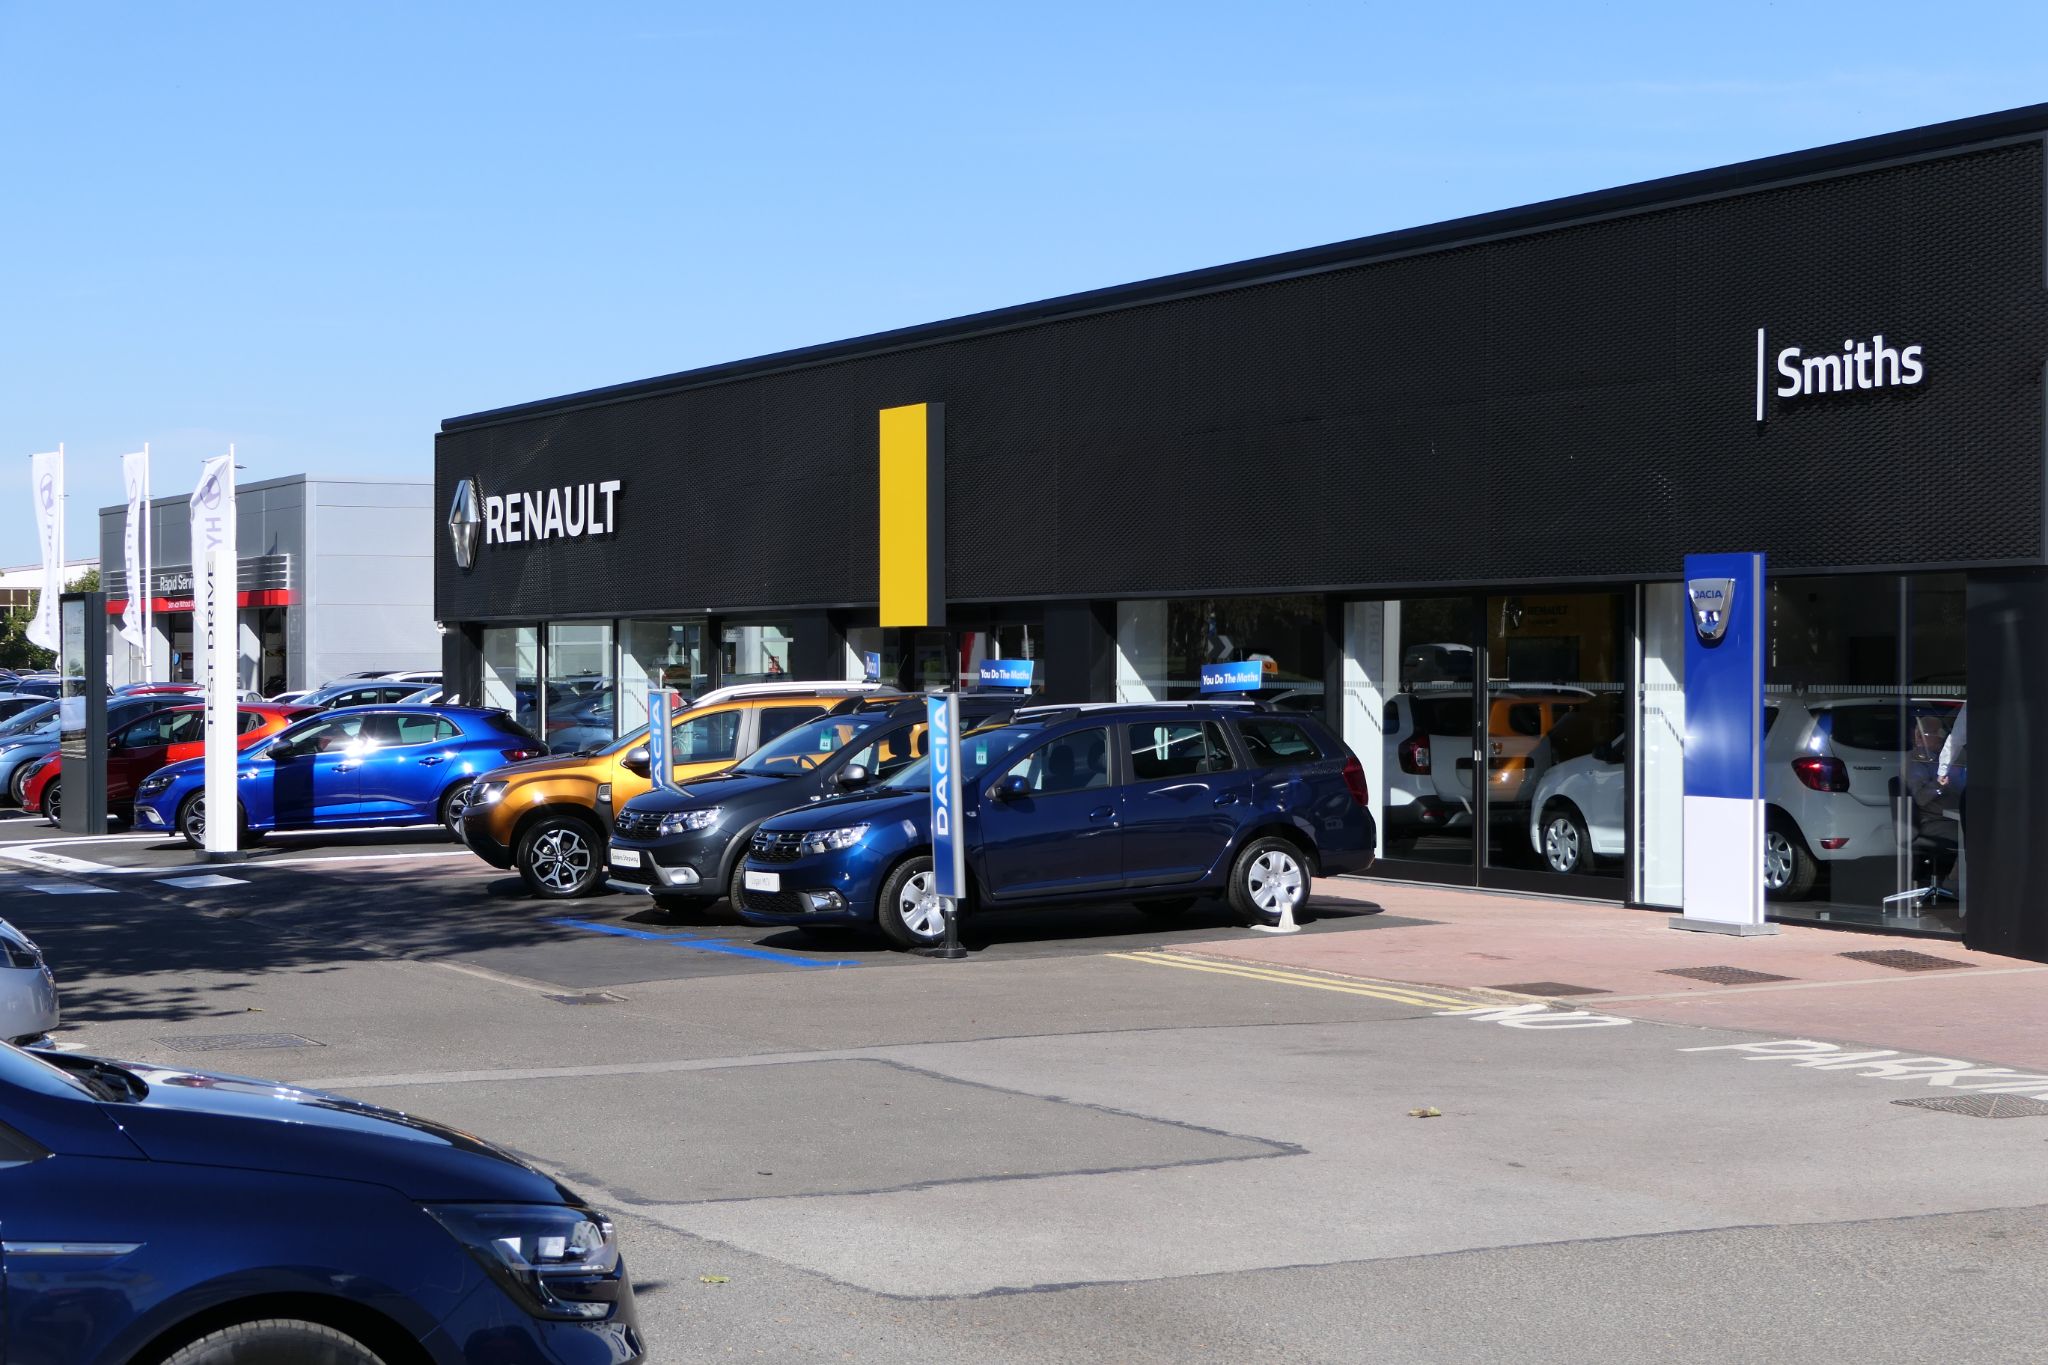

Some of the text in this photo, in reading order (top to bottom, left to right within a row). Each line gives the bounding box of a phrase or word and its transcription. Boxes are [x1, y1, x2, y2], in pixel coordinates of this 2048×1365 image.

[1777, 335, 1923, 397] Smiths
[486, 480, 621, 544] RENAULT
[160, 573, 194, 594] Rapid Servi
[1694, 590, 1723, 598] DACIA
[980, 668, 1030, 680] You Do The Maths
[1202, 672, 1259, 686] You Do The Maths
[651, 699, 663, 787] ACIA
[934, 702, 949, 836] DACIA
[1431, 1003, 1633, 1030] NO
[1676, 1039, 2048, 1101] PARKI
